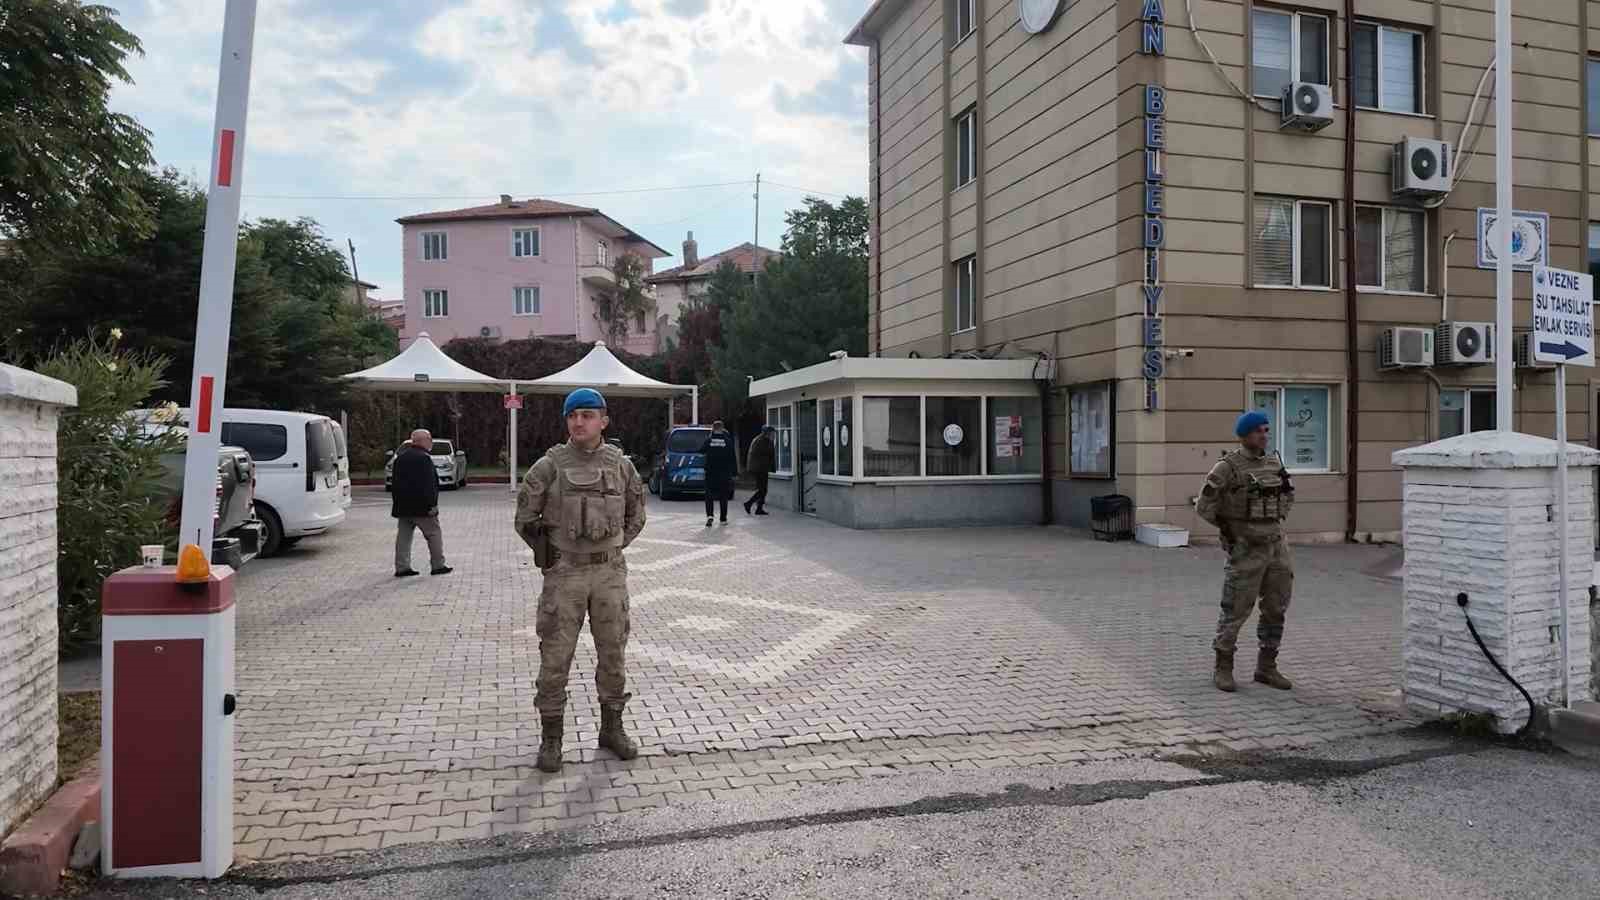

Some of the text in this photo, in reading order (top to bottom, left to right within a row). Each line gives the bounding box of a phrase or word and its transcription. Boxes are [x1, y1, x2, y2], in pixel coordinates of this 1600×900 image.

[1143, 83, 1166, 409] BELEDİYESİ
[1548, 271, 1579, 291] VEZNE
[1536, 294, 1590, 316] SU TAHSİLAT
[1534, 315, 1562, 335] EMLAK
